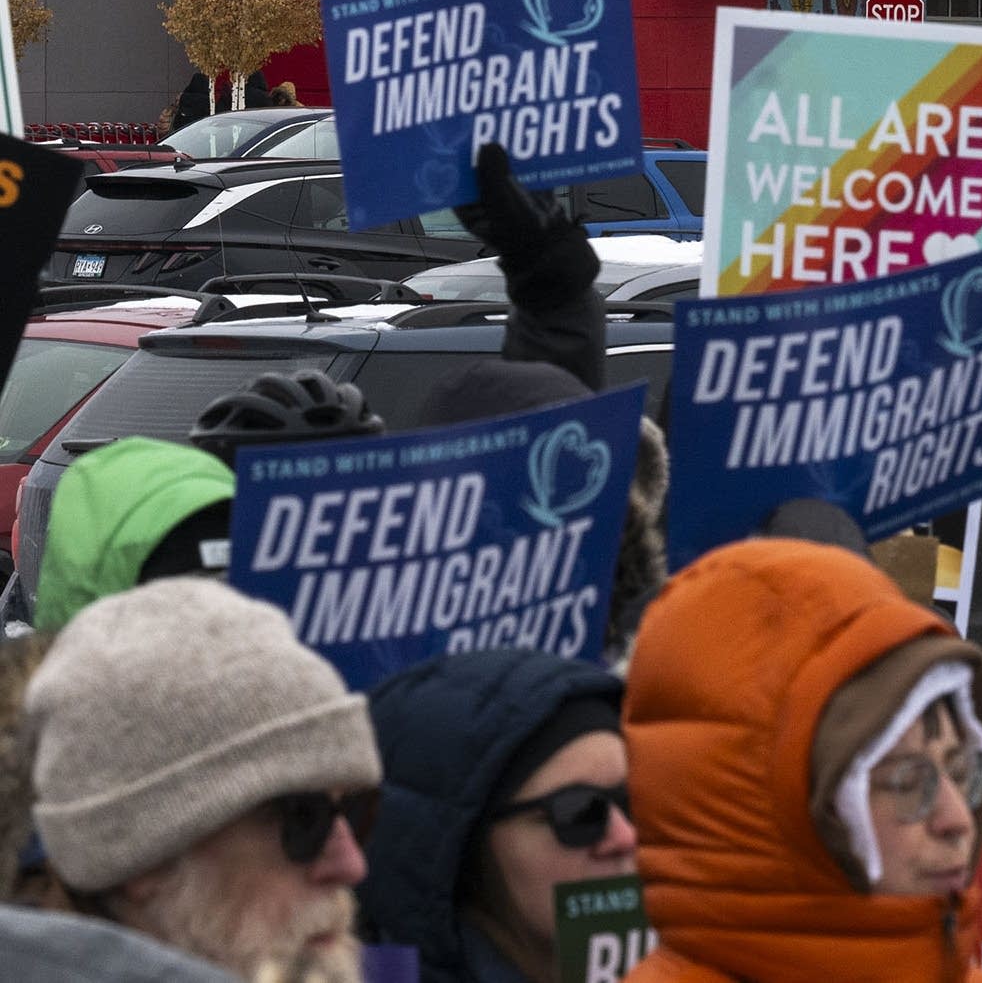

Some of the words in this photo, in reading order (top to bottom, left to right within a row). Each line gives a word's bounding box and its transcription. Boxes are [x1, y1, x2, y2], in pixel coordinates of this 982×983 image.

[344, 2, 486, 85] DEFEND
[871, 4, 920, 23] STOP
[373, 40, 598, 136] IMMIGRANT
[748, 90, 857, 151] ALL
[471, 92, 622, 168] RIGHTS
[739, 221, 914, 284] HERE
[687, 299, 760, 327] STAND
[765, 293, 819, 321] WITH
[823, 272, 942, 315] IMMIGRANTS
[692, 315, 903, 404] DEFEND
[250, 457, 330, 482] STAND
[335, 451, 394, 475] WITH
[400, 425, 529, 466] IMMIGRANTS
[251, 472, 486, 572] DEFEND
[293, 517, 594, 647] IMMIGRANT
[565, 887, 640, 919] STAND
